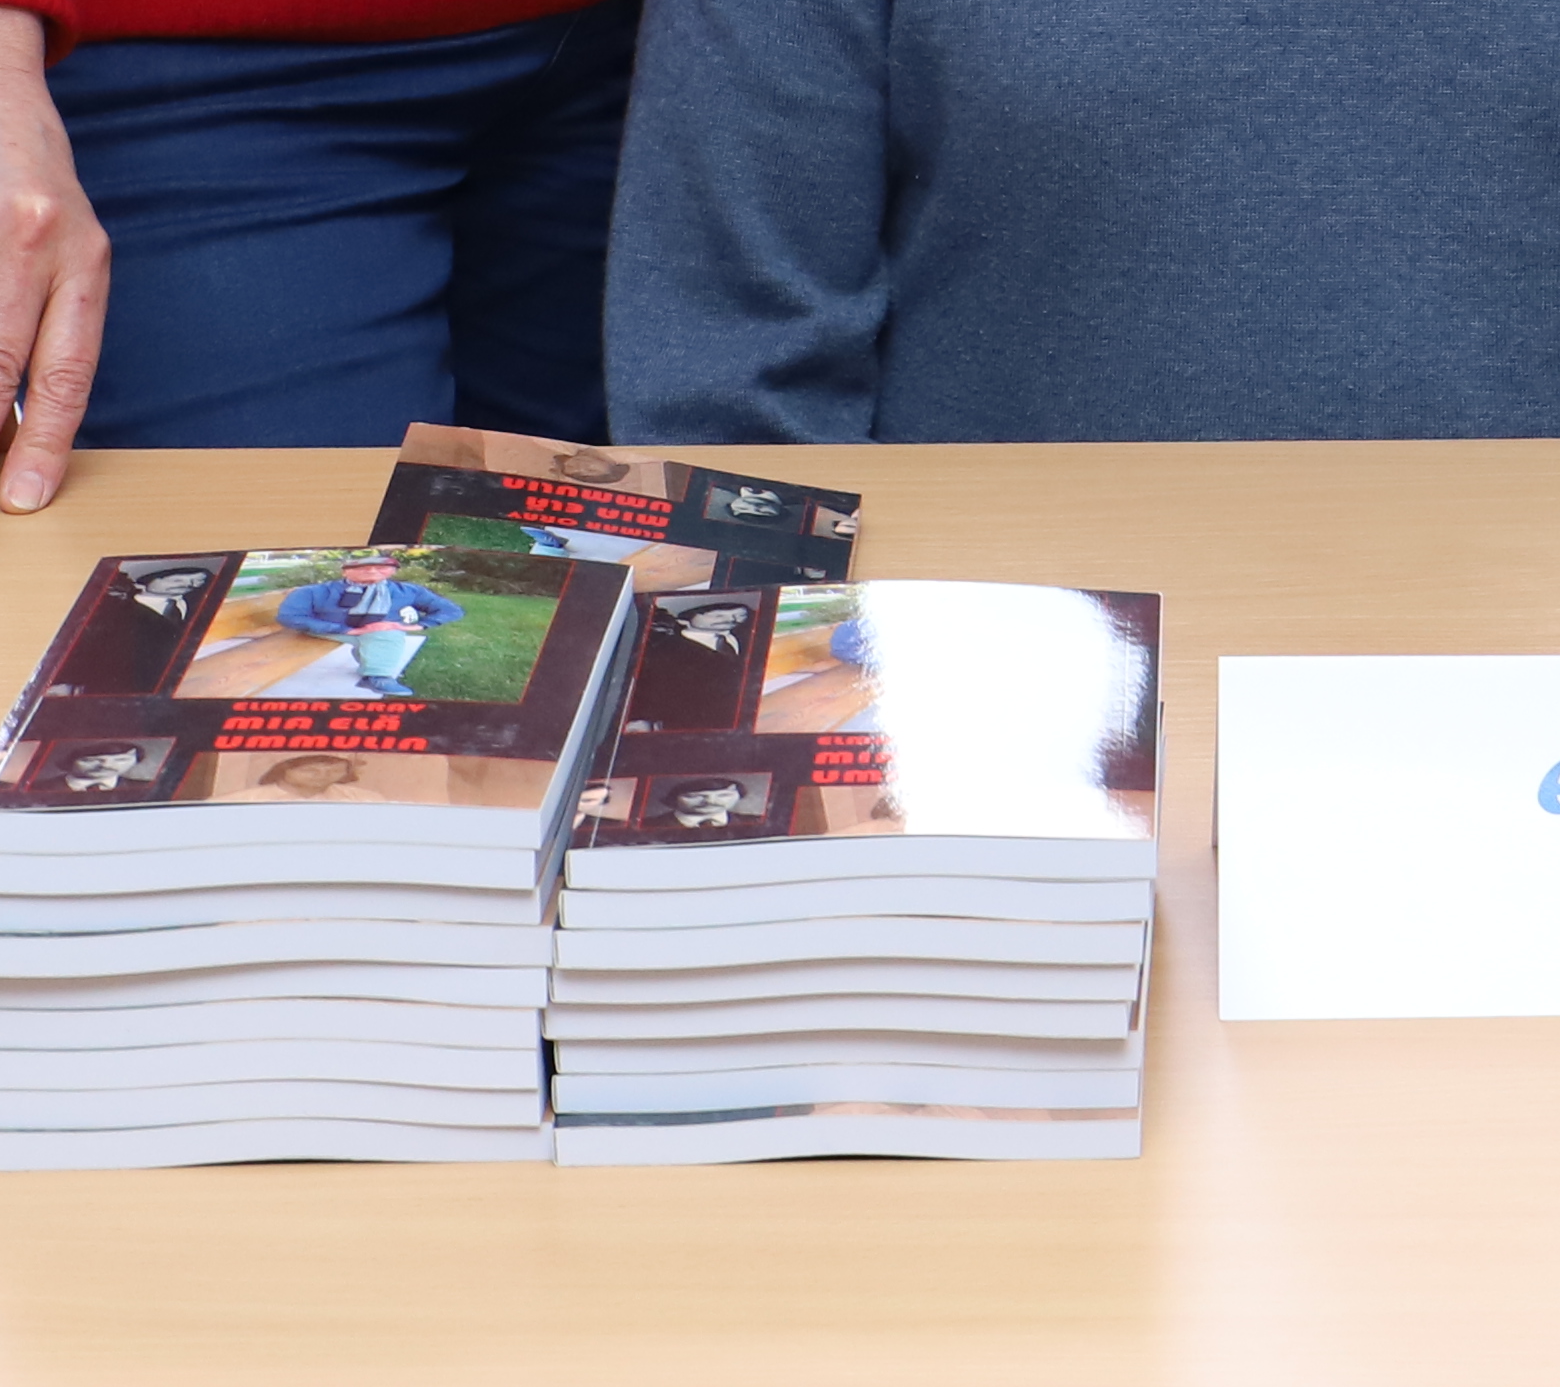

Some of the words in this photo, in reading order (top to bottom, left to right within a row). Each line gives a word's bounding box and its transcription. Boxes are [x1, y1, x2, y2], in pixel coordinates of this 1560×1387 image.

[507, 511, 579, 527] ORAV
[596, 507, 670, 528] MIA
[585, 521, 666, 540] ELMAR
[232, 701, 331, 712] ELMAR
[339, 701, 427, 713] ORAV
[222, 716, 315, 730] MIA
